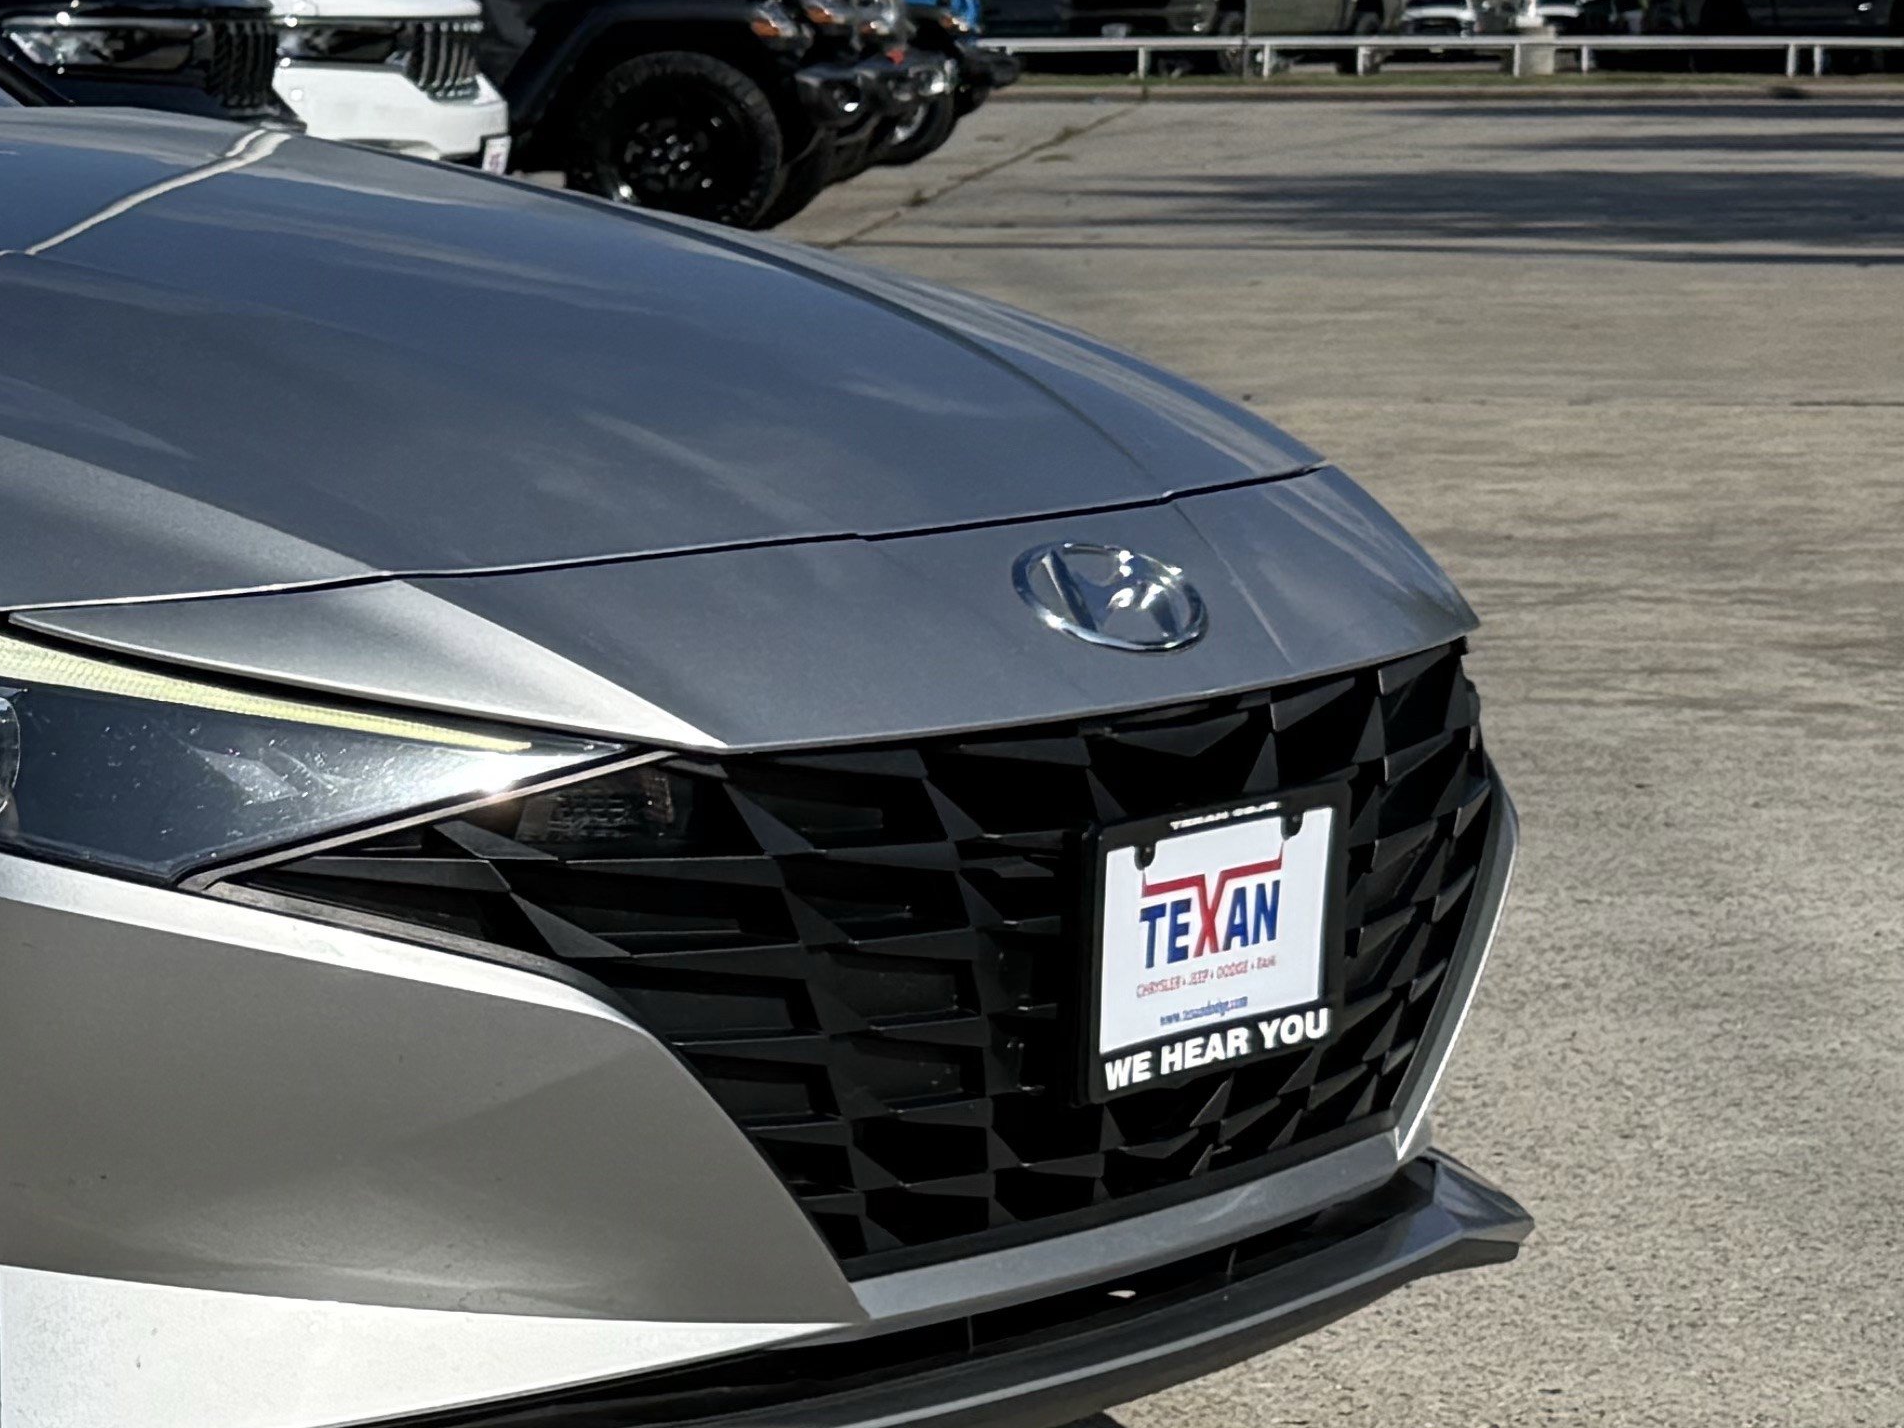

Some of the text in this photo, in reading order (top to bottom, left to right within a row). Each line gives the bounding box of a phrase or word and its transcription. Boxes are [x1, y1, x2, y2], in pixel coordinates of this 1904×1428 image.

[1139, 867, 1283, 969] TEXAN
[1105, 1007, 1331, 1091] WE HEAR YOU
